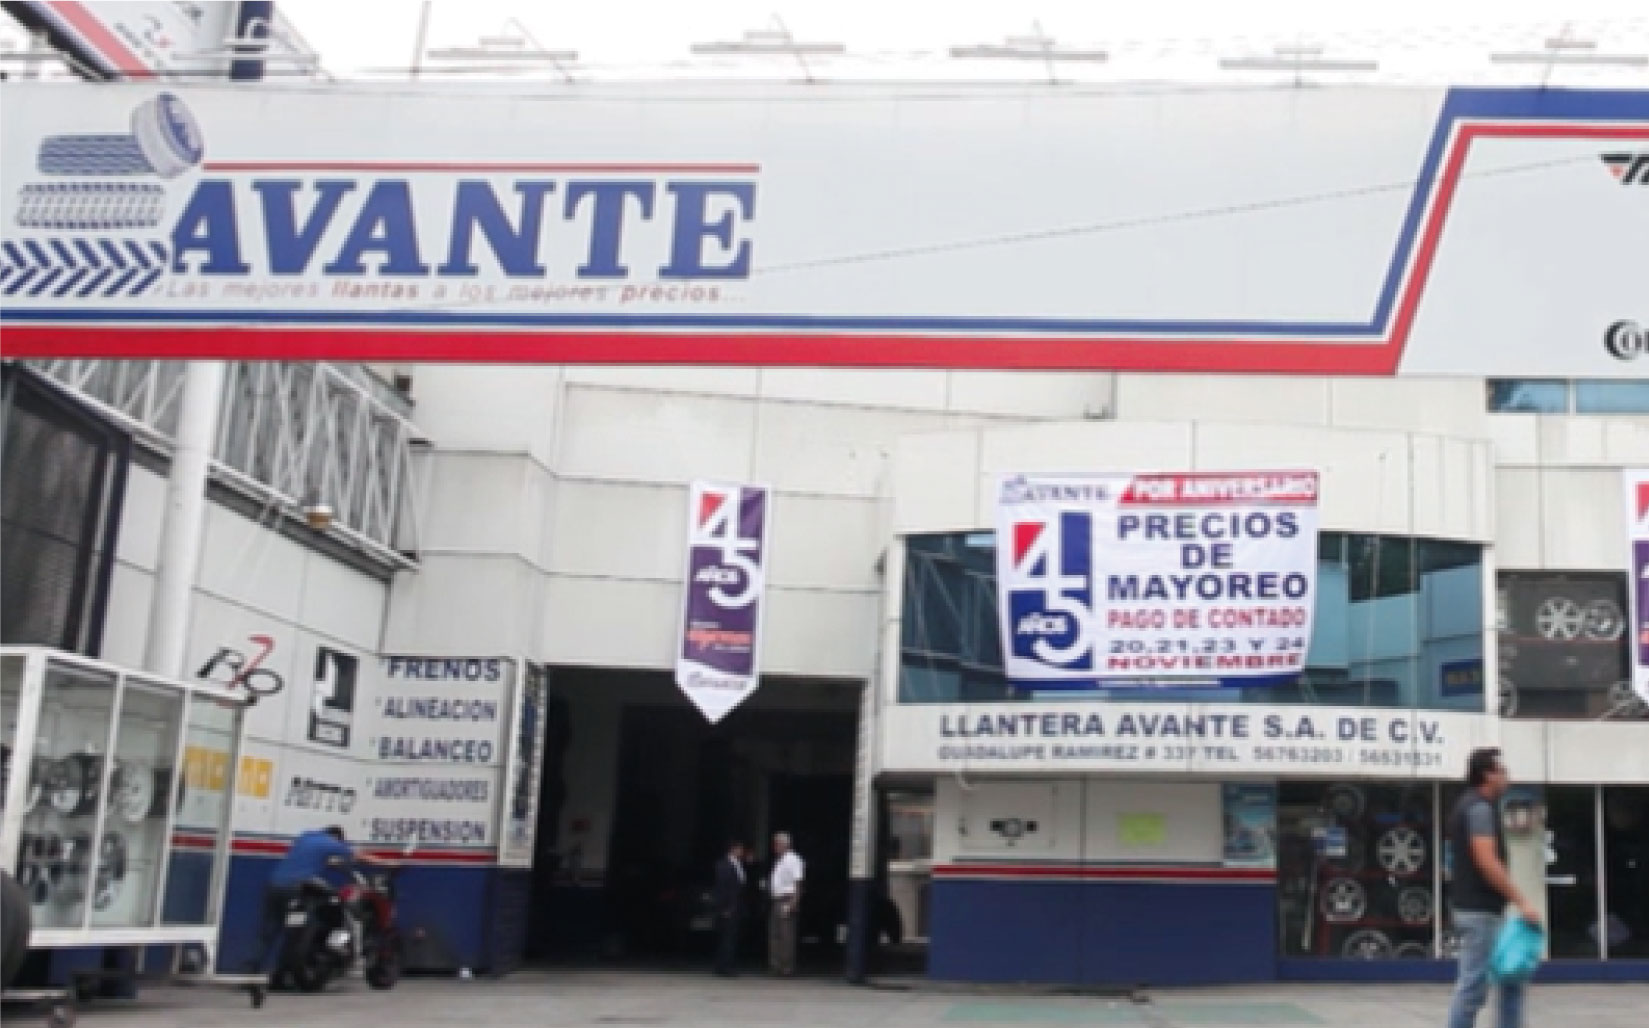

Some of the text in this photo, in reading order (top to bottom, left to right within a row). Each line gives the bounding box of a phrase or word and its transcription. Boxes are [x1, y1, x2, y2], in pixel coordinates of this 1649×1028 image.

[170, 179, 757, 279] AVANTE
[165, 280, 210, 298] Las
[221, 280, 319, 303] mejores
[331, 279, 420, 298] llantas
[433, 283, 447, 298] a
[459, 280, 495, 299] los
[507, 282, 608, 304] mejores
[1117, 511, 1301, 540] PRECIOS
[1181, 543, 1234, 569] DE
[1107, 573, 1308, 600] MAYOREO
[1107, 606, 1306, 629] PAGO DE CONTADO
[1249, 638, 1265, 651] Y
[1276, 636, 1304, 651] 24
[388, 657, 501, 682] FRENOS
[1107, 653, 1302, 670] NOVIEMBRE
[382, 696, 497, 721] ALINEACION
[939, 712, 1105, 738] LLANTERA
[1115, 712, 1250, 738] AVANTE
[1263, 714, 1327, 741] S.A.
[1338, 716, 1380, 742] DE
[377, 736, 494, 762] BALANCEO
[937, 743, 1047, 760] GUADALUPE
[1052, 743, 1140, 760] RAMIREZ
[373, 776, 489, 803] AMORTIGUADORES
[371, 818, 486, 842] SUSPENSION
